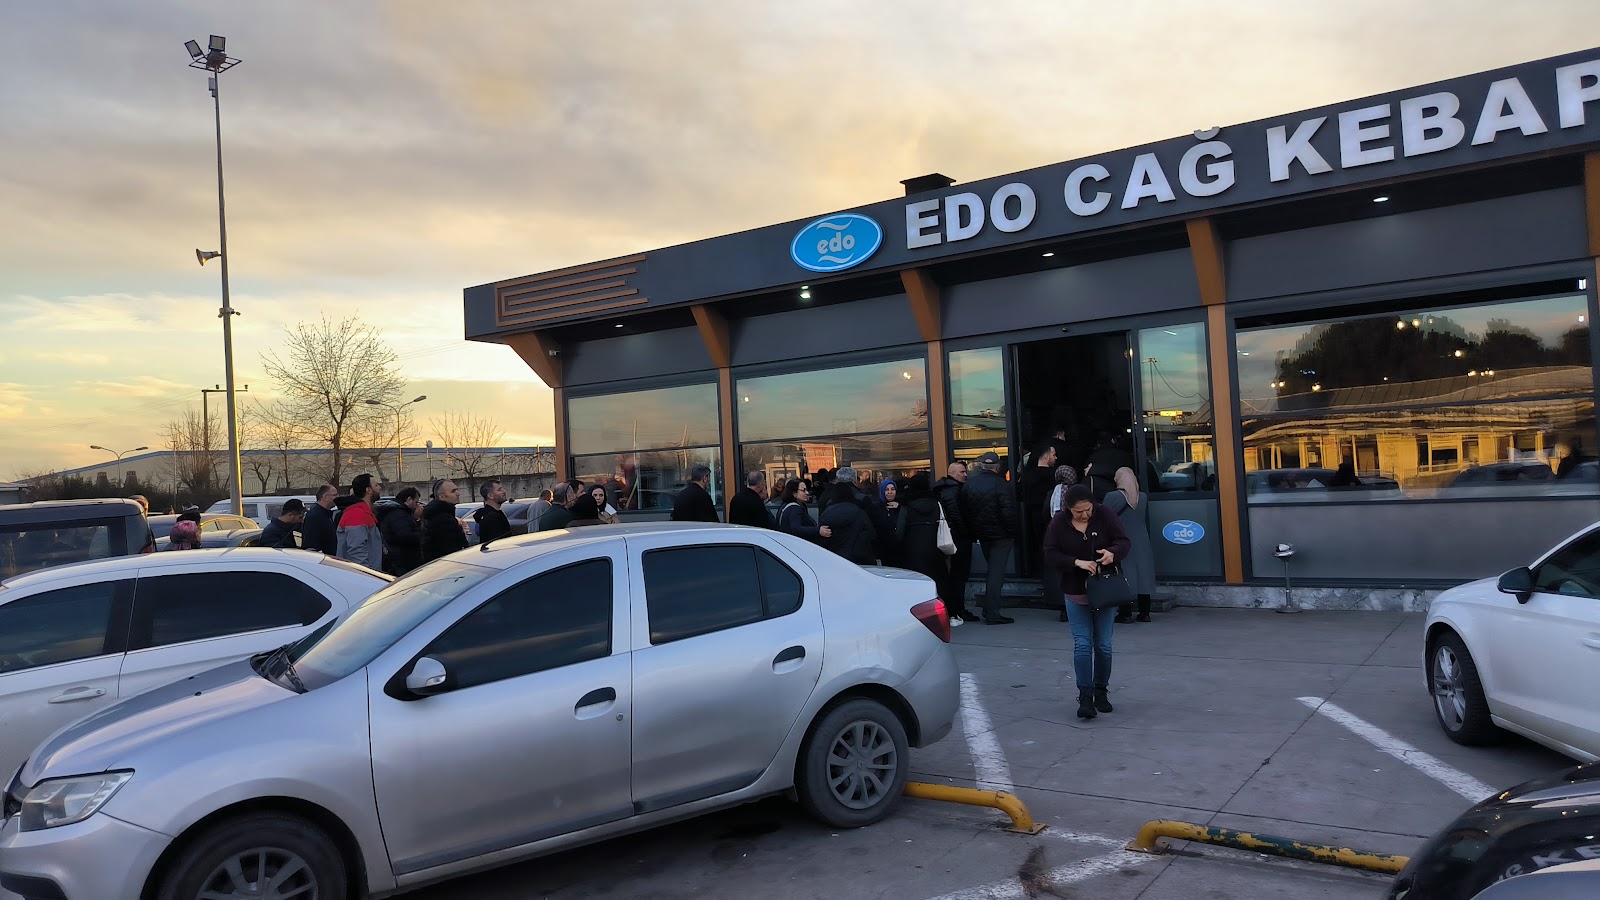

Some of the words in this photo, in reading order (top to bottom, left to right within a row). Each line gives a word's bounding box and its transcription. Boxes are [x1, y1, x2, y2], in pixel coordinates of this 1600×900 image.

[905, 181, 1037, 250] EDO
[1064, 126, 1236, 218] CAĞ
[1266, 59, 1600, 183] KEBAP
[816, 231, 856, 255] edo
[1173, 527, 1195, 538] edo
